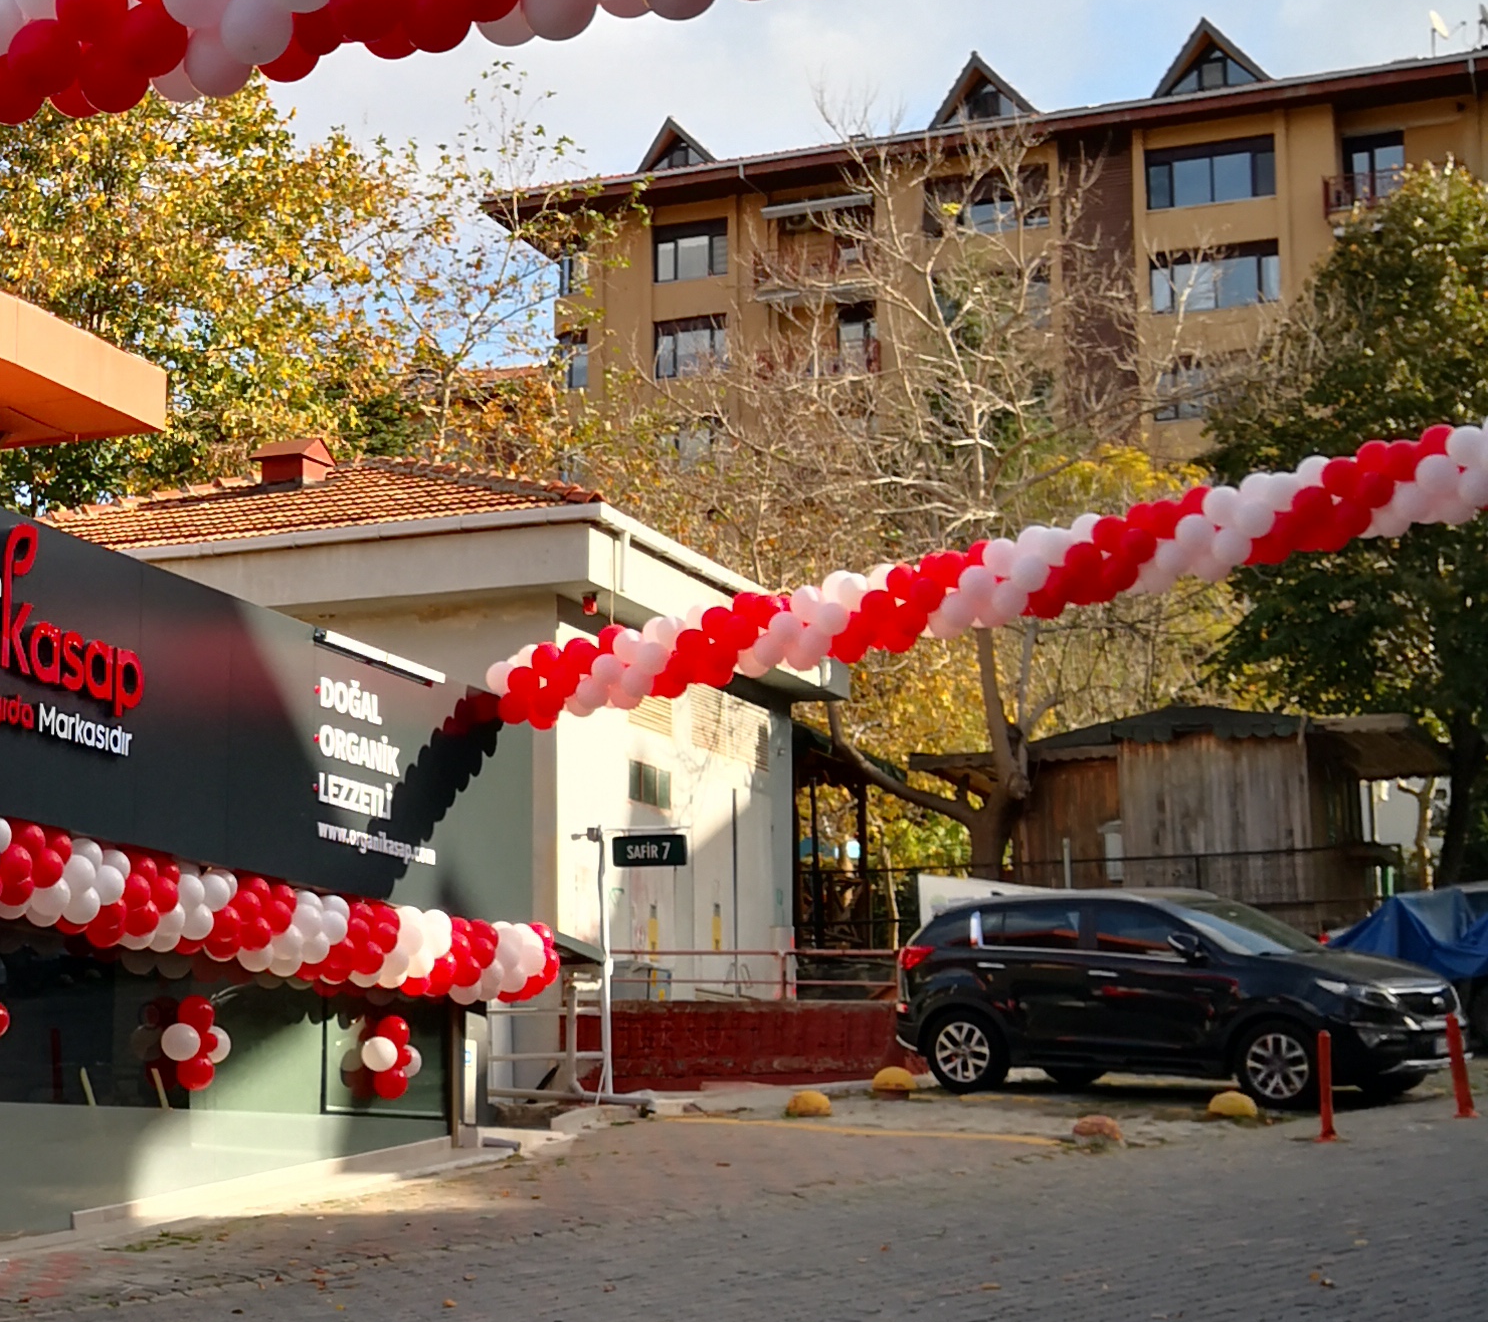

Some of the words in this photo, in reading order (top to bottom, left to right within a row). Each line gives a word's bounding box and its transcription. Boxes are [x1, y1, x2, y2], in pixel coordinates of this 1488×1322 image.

[319, 676, 383, 725] DOĞAL
[38, 702, 133, 757] Markasıdır
[318, 724, 401, 777] ORGANİK
[318, 771, 393, 821] LEZZETLİ
[317, 821, 436, 866] www.organikasap.com
[626, 841, 659, 860] SAFİR
[661, 841, 671, 861] 7
